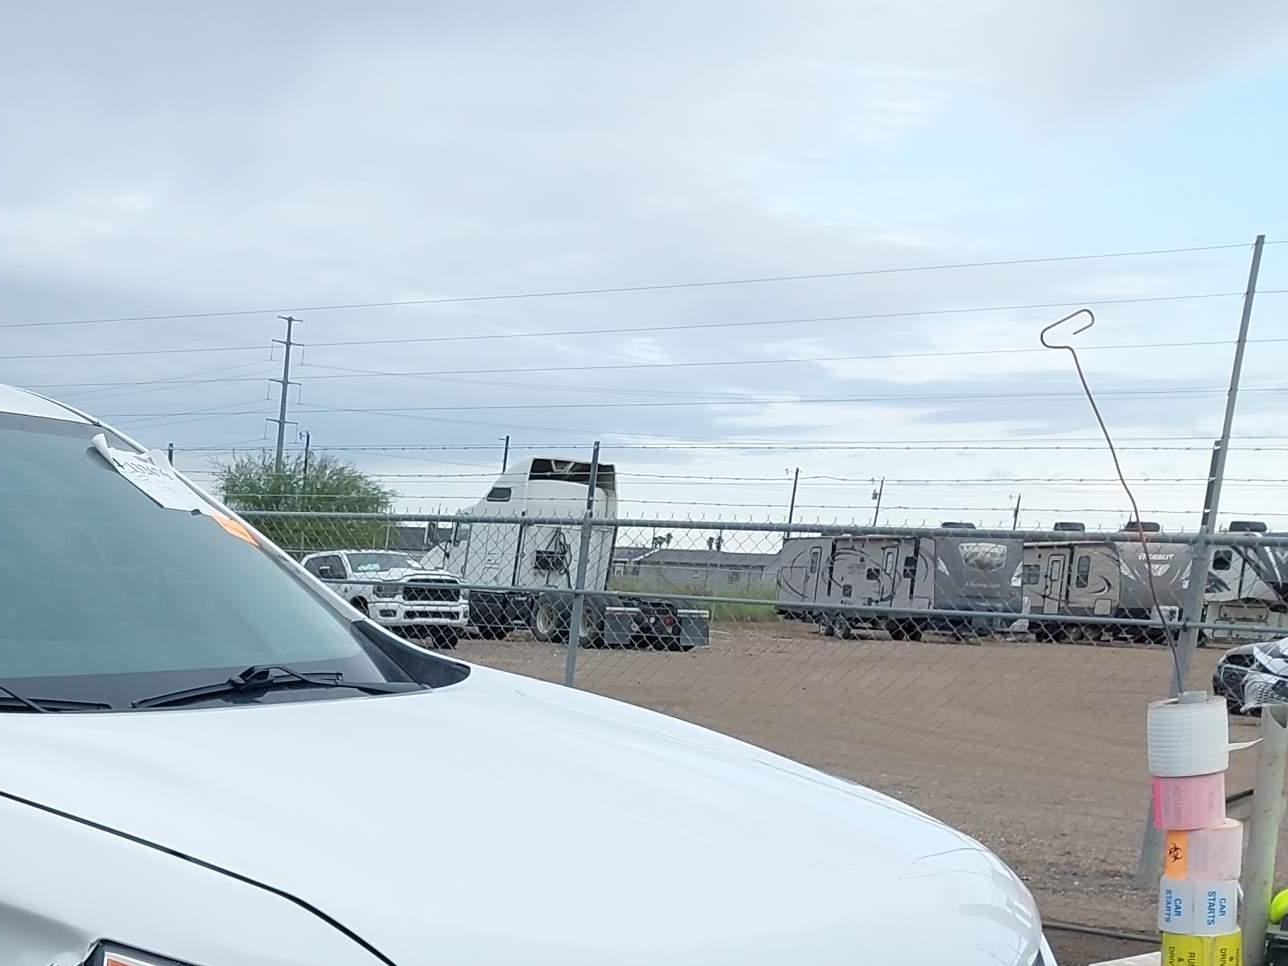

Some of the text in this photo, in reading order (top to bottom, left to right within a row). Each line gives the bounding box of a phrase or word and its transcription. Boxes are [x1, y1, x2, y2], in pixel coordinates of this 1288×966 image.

[1165, 888, 1173, 923] STARTS
[1174, 898, 1183, 917] CAR
[1206, 890, 1217, 926] STARTS
[1219, 897, 1227, 917] CAR
